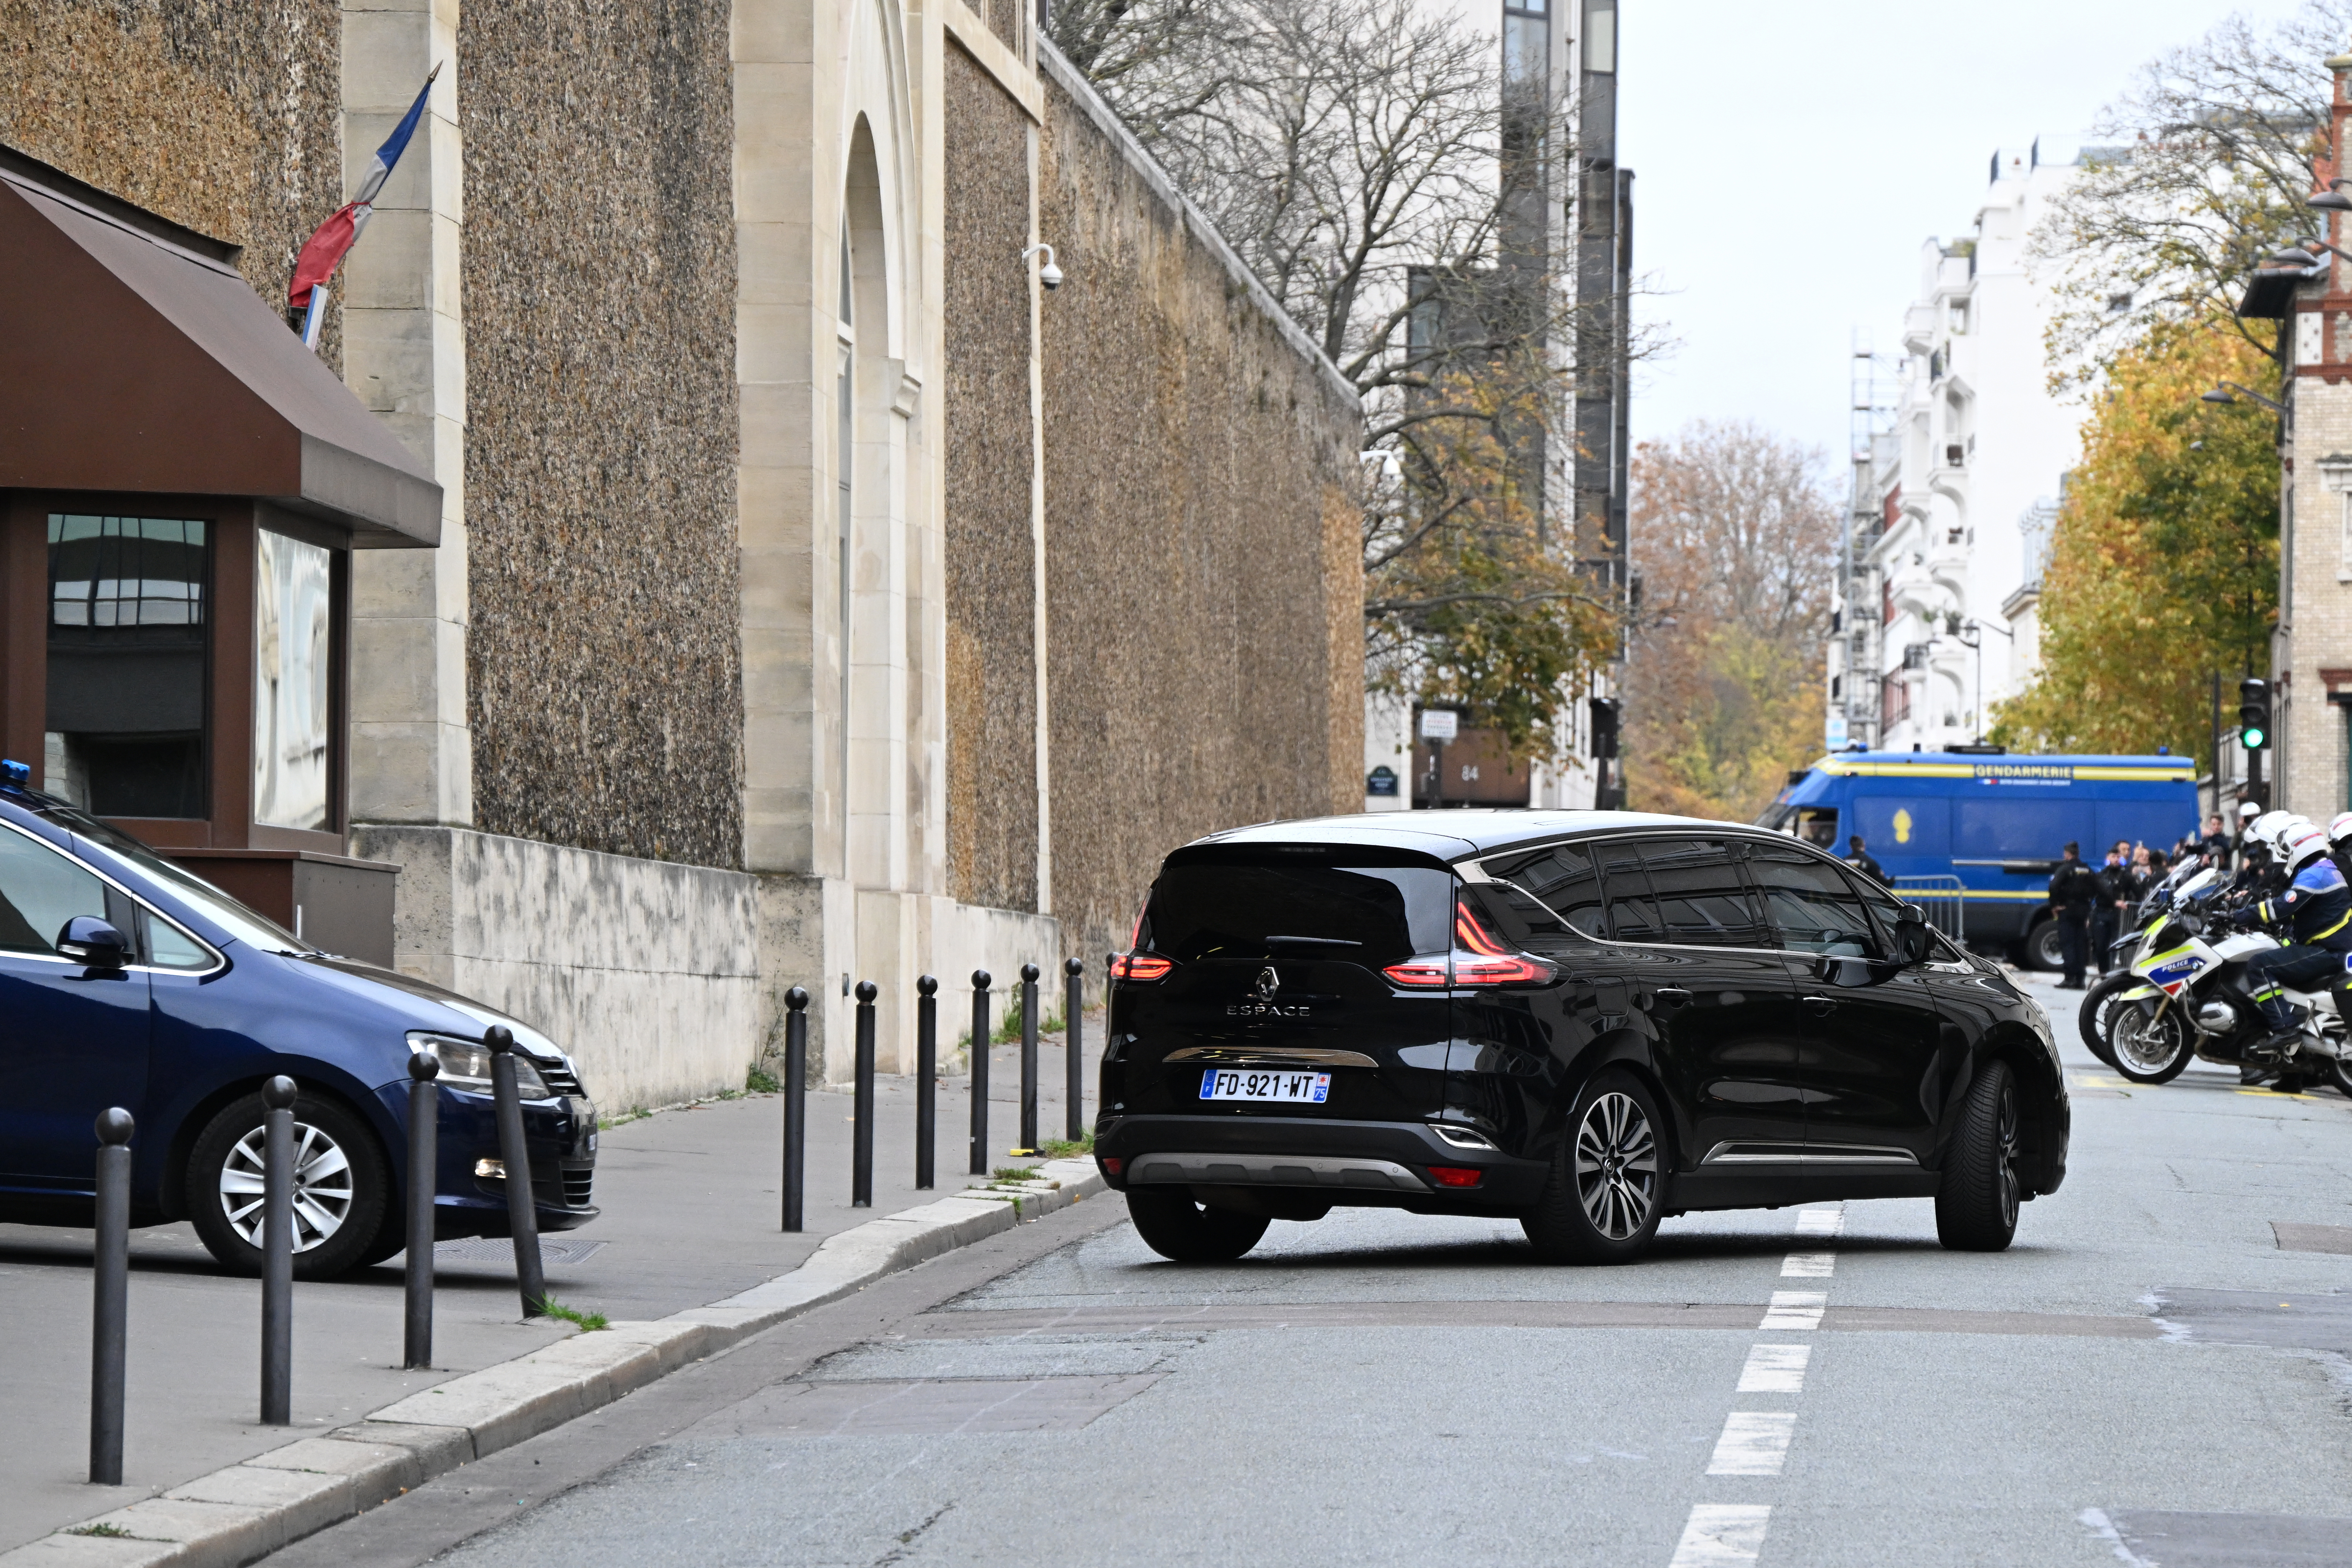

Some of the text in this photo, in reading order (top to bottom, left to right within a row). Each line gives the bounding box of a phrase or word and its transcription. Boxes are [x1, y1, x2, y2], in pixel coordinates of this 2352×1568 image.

[1462, 765, 1478, 781] 84
[1976, 764, 2071, 778] GENDARMERIE
[2162, 959, 2188, 972] POLICE
[1227, 1006, 1310, 1016] ESPACE
[1215, 1074, 1313, 1098] FD-921-WT
[1315, 1088, 1326, 1098] 75
